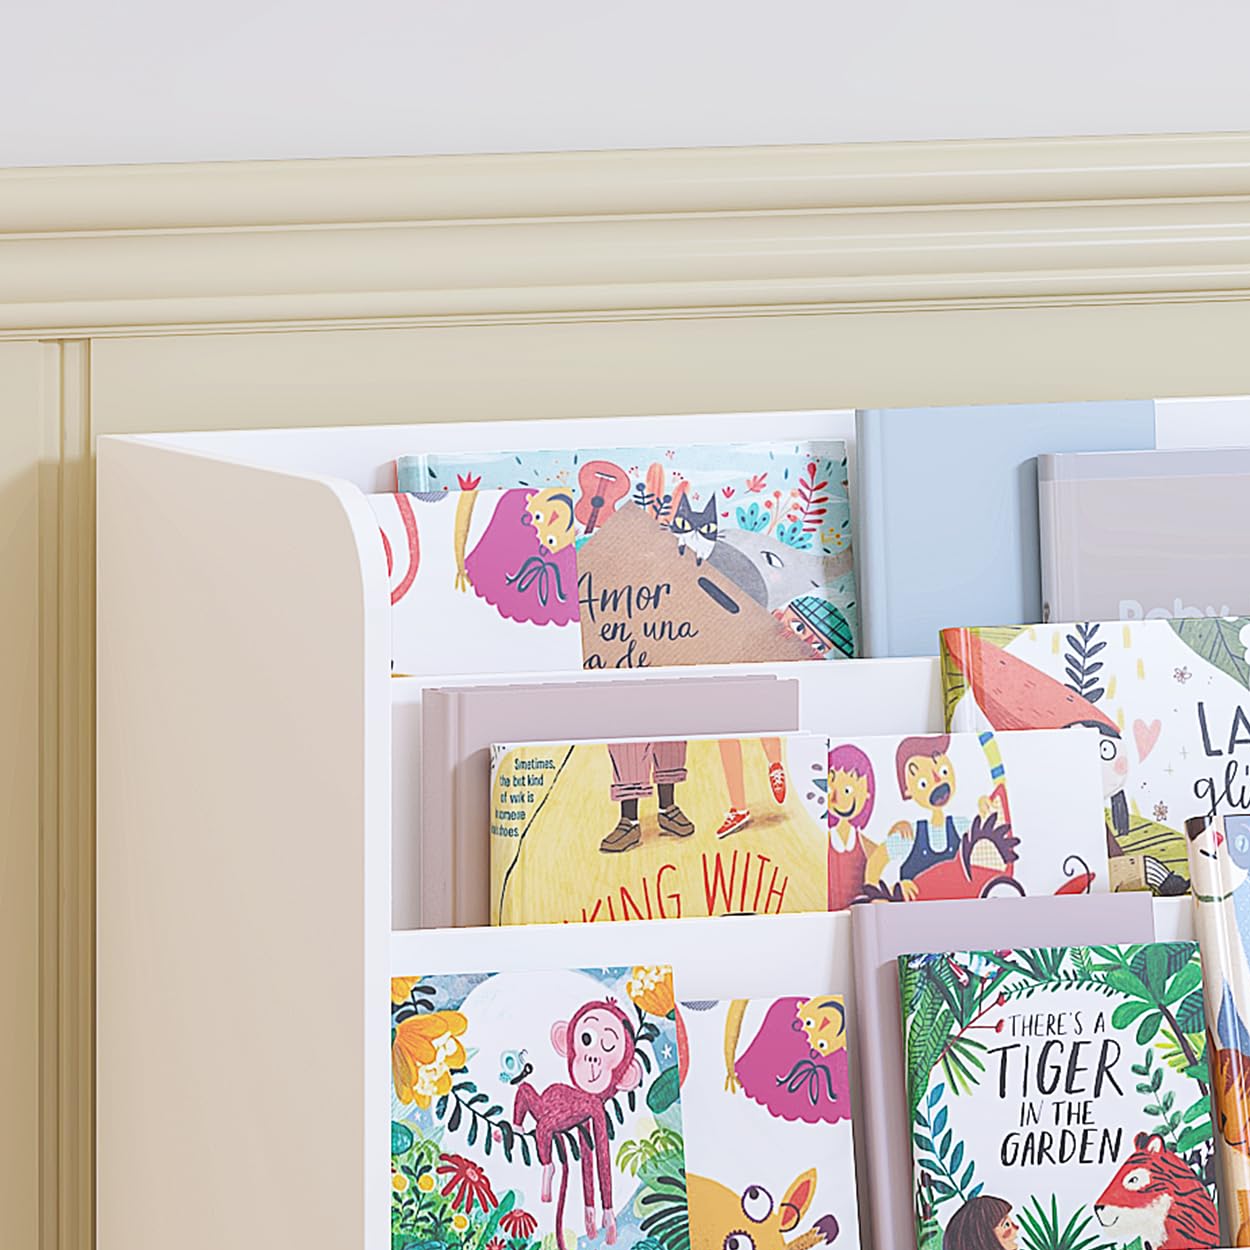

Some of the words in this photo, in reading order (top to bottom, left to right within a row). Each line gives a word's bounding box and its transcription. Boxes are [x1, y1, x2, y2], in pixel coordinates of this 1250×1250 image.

[578, 571, 670, 623] Amor
[599, 622, 632, 642] en
[643, 620, 699, 641] una
[702, 850, 788, 916] WITH
[1008, 1011, 1083, 1037] THERE'S
[1094, 1012, 1105, 1034] A
[987, 1039, 1124, 1098] TIGER
[1020, 1100, 1044, 1127] IN
[1052, 1100, 1095, 1125] THE
[1001, 1127, 1122, 1166] GARDEN
